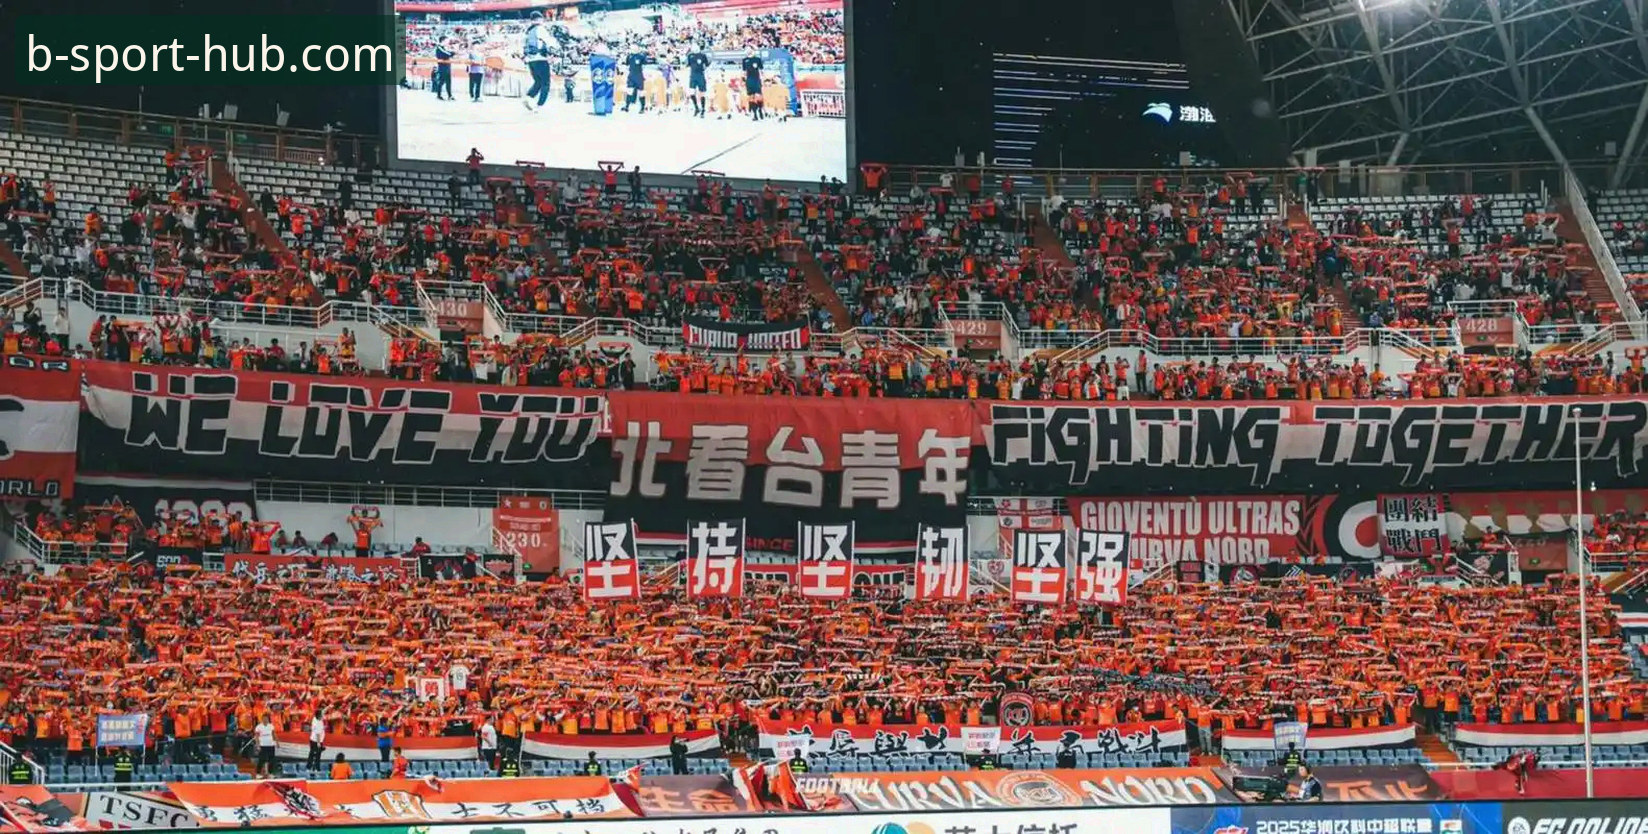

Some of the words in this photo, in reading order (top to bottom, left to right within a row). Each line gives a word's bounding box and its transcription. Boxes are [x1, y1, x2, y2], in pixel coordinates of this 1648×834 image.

[956, 320, 987, 335] 429
[1466, 319, 1498, 333] 428
[124, 371, 238, 454] WE
[258, 380, 453, 464] LOVE
[468, 390, 604, 464] YOU
[1313, 402, 1648, 486] TOGETHER
[610, 420, 971, 510] 北看台青年
[506, 532, 541, 548] 230
[1081, 497, 1201, 536] GIOVENTÙ
[1208, 501, 1300, 535] ULTRAS
[584, 524, 633, 597] 坚
[692, 522, 742, 594] 持
[802, 525, 848, 596] 坚
[921, 526, 968, 597] 韧
[1015, 532, 1062, 600] 坚
[1078, 531, 1125, 602] 强
[1131, 537, 1197, 566] URVA
[1203, 537, 1270, 565] NORD
[99, 794, 189, 829] TSFC
[1080, 775, 1216, 806] NORD
